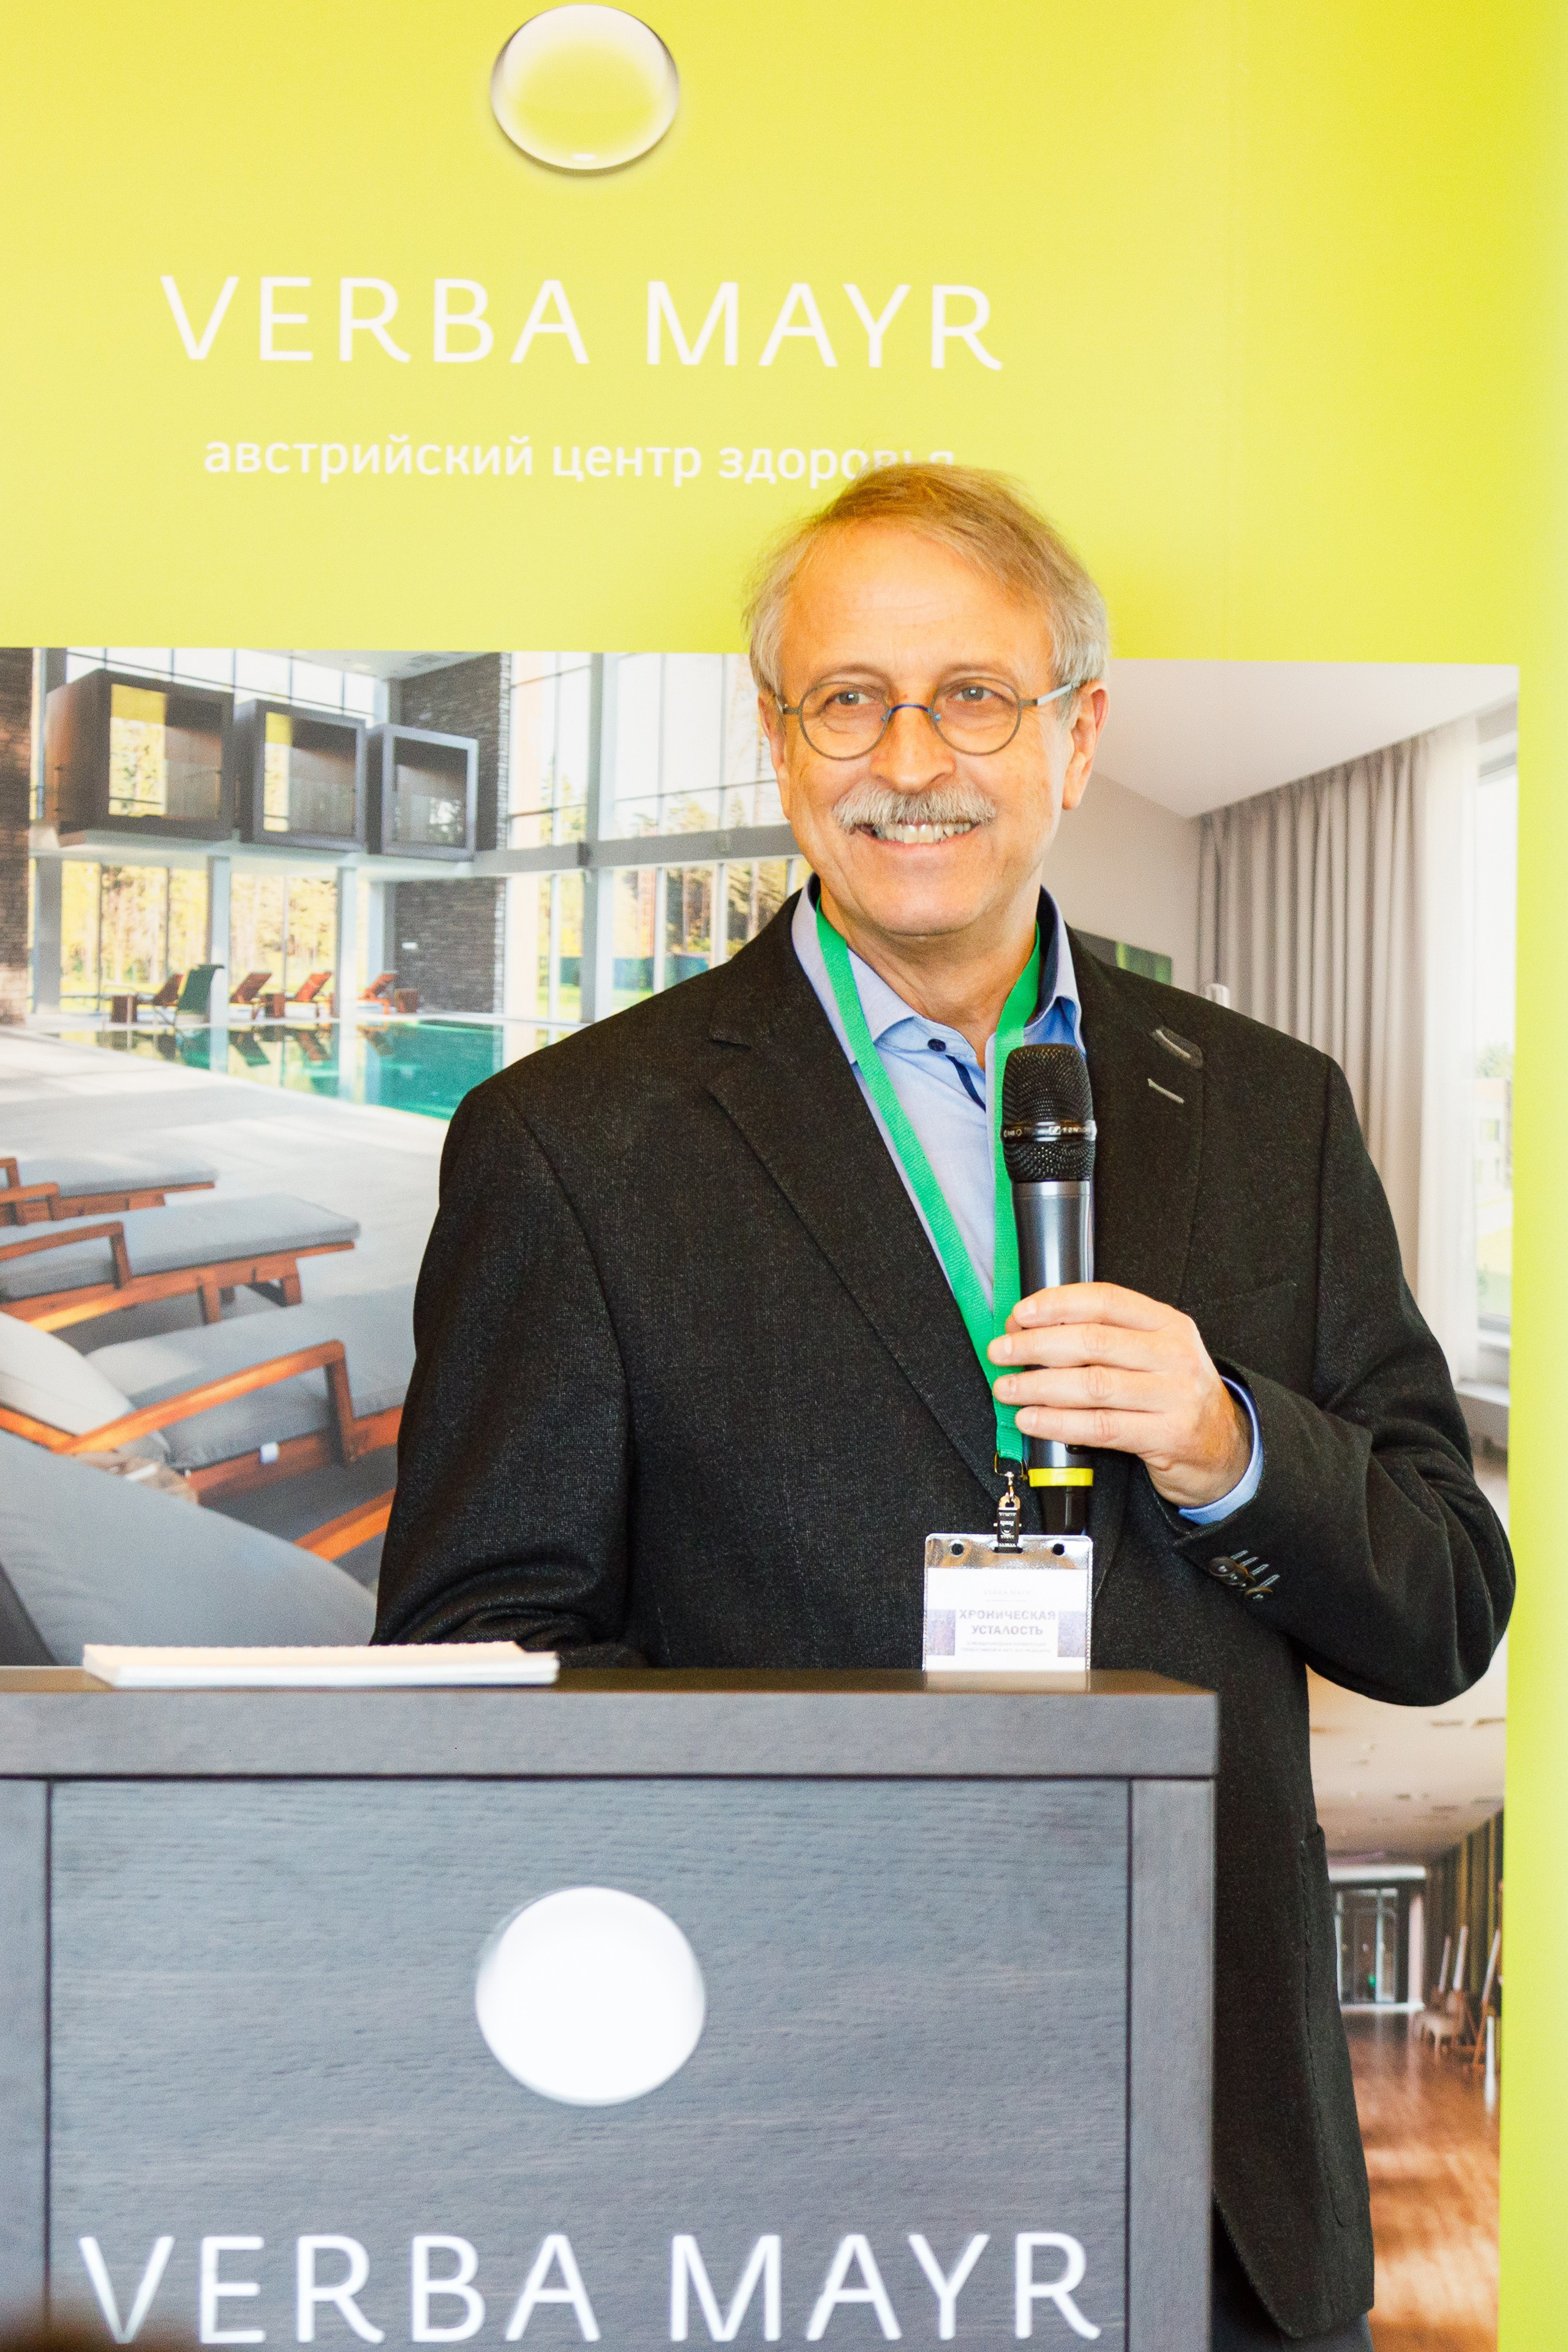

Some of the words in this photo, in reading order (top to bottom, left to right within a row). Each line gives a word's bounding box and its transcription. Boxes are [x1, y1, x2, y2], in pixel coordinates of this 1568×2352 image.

[159, 274, 590, 365] VERBA
[646, 280, 1004, 371] MAYR
[203, 433, 533, 484] австрийский
[552, 445, 703, 488] центр
[959, 1610, 1056, 1621] ХРОНИЧЕСКАЯ
[971, 1625, 1044, 1635] УСТАЛОСТЬ
[78, 2234, 600, 2345] VERBA
[669, 2231, 1101, 2342] MAYR
